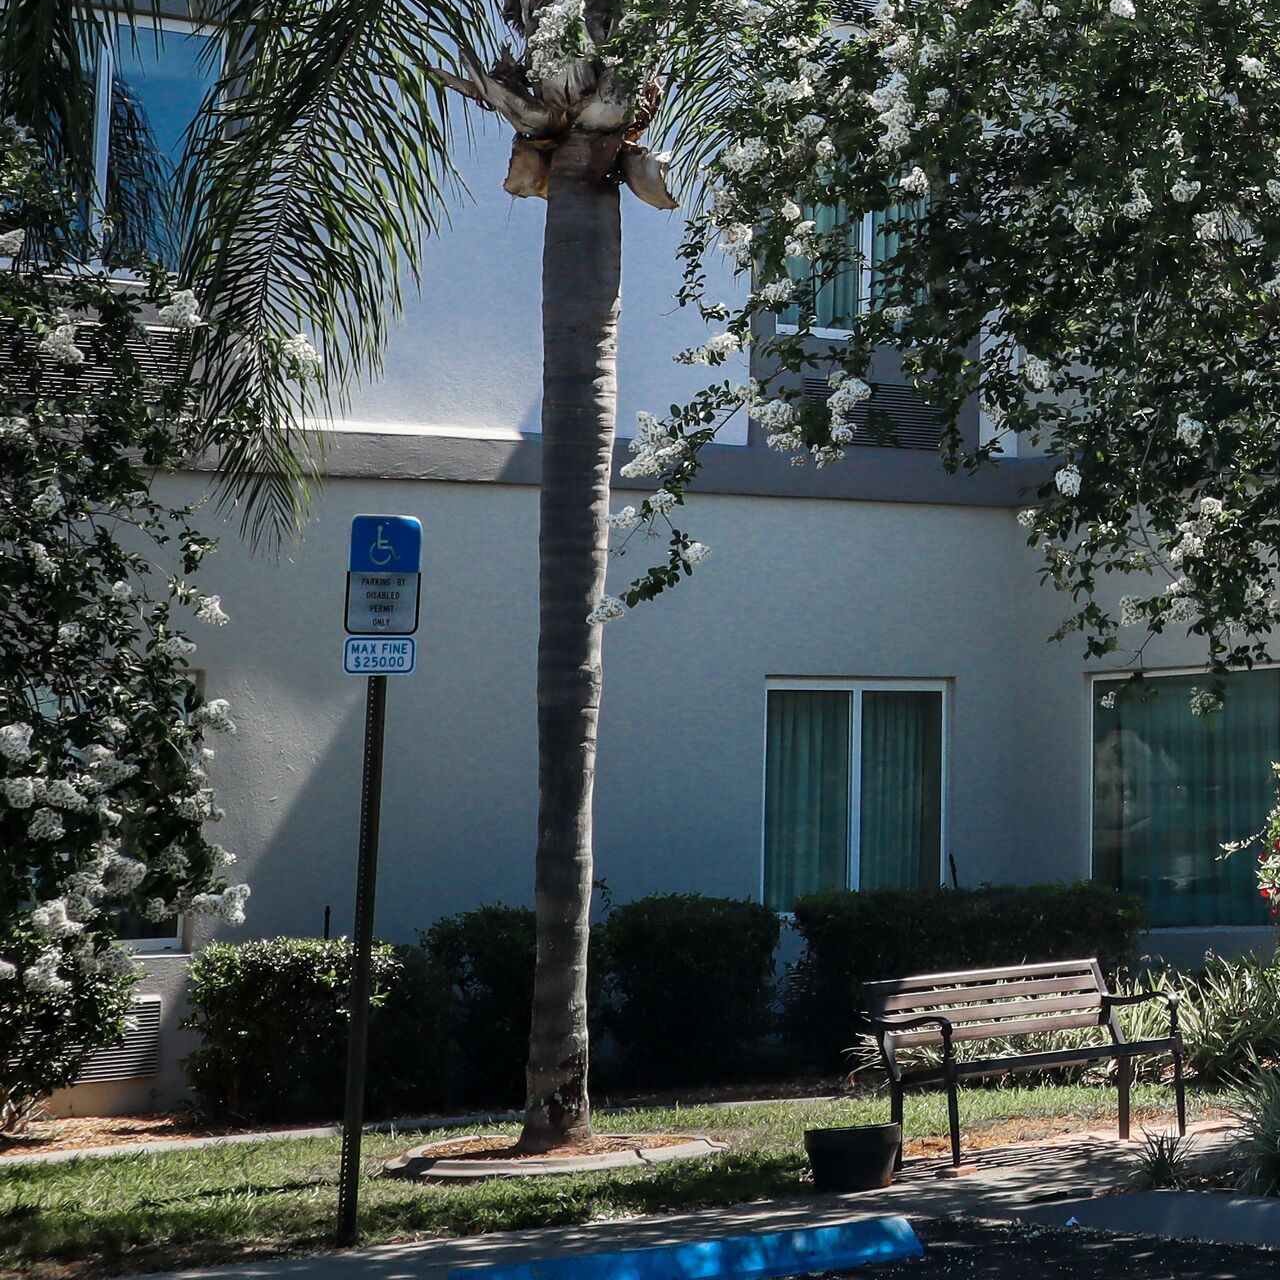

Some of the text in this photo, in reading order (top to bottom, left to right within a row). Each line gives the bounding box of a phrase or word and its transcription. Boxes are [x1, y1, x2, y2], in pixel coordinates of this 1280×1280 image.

[361, 577, 406, 586] PARKING BY
[366, 591, 400, 600] DISABLED
[369, 604, 395, 613] PERMIT
[372, 618, 390, 627] ONLY
[351, 643, 409, 655] MAX FINE
[354, 656, 405, 669] $250.00
